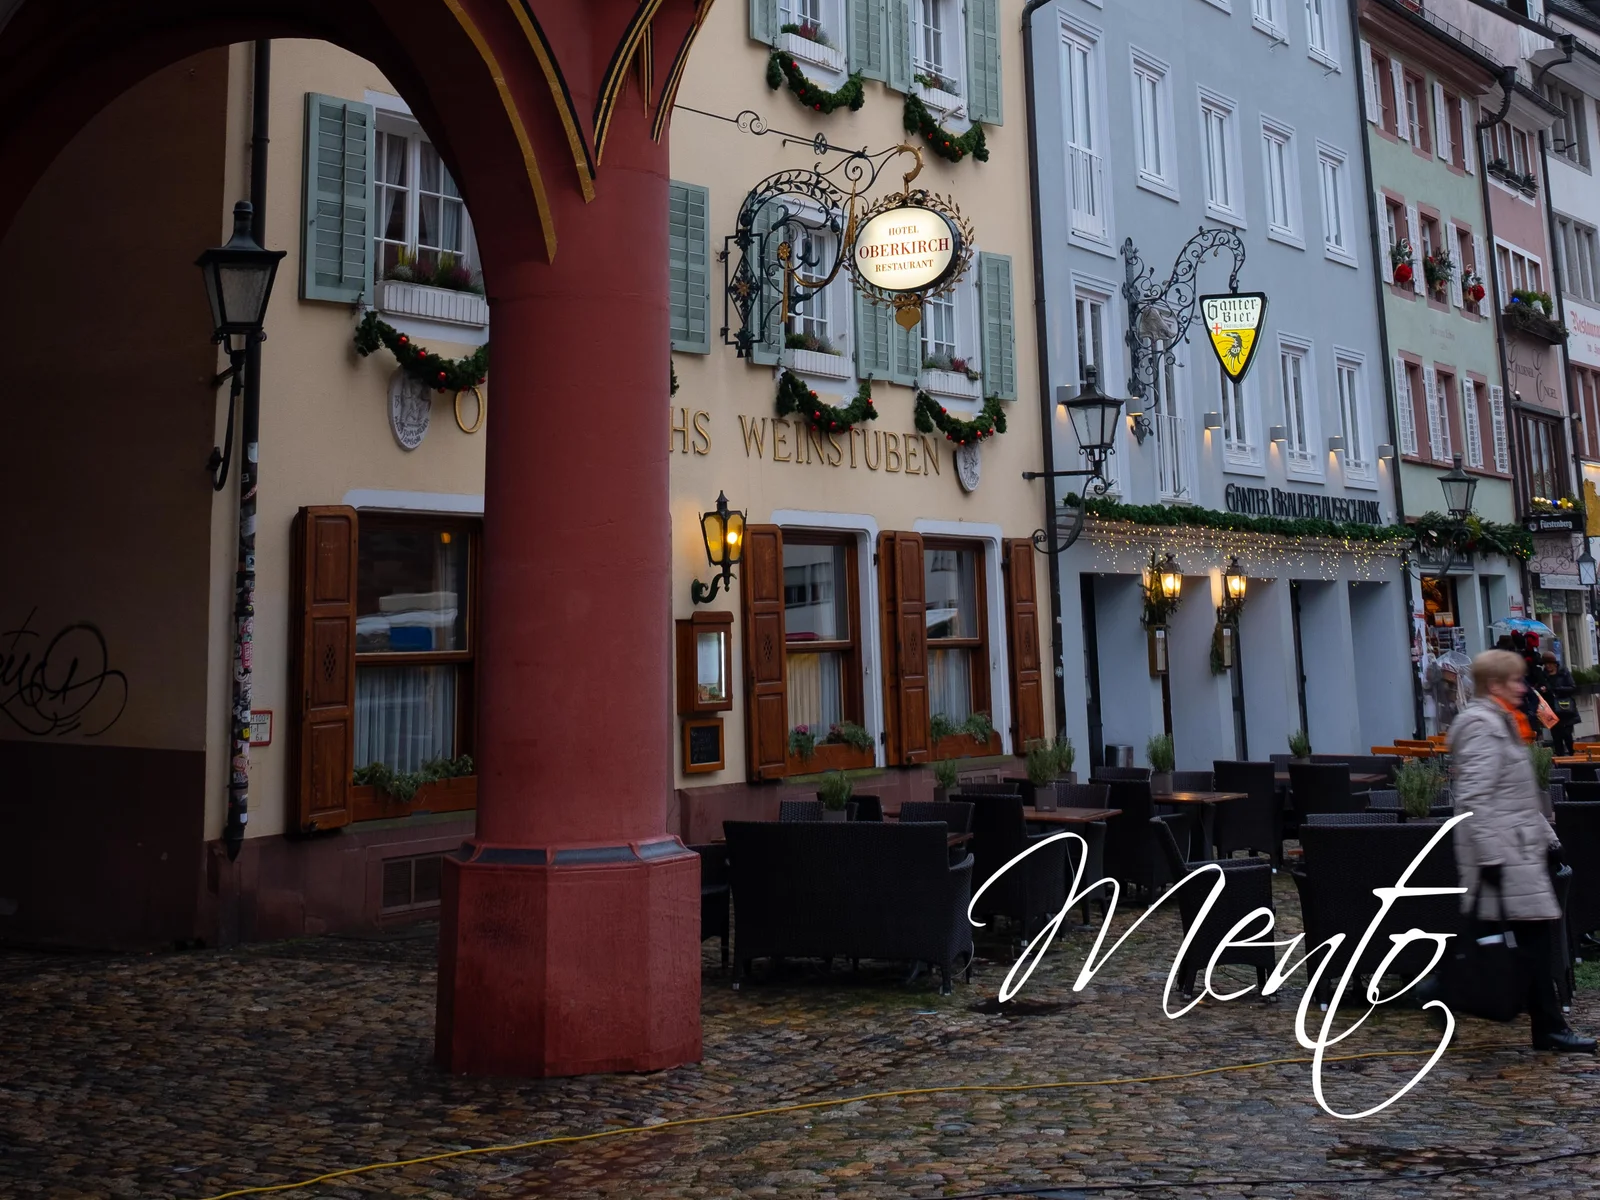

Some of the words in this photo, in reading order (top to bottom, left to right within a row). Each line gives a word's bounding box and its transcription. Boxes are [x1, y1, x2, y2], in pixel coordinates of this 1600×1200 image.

[888, 225, 919, 236] HOTEL
[859, 237, 950, 259] OBERKIRCH
[875, 259, 934, 273] RESTAURANT
[738, 414, 941, 476] WEINSTUBEN
[1225, 483, 1271, 515] GANTER
[1271, 487, 1382, 524] BRAUEREIAUSSCHANK
[1540, 519, 1573, 529] Fürstenberg
